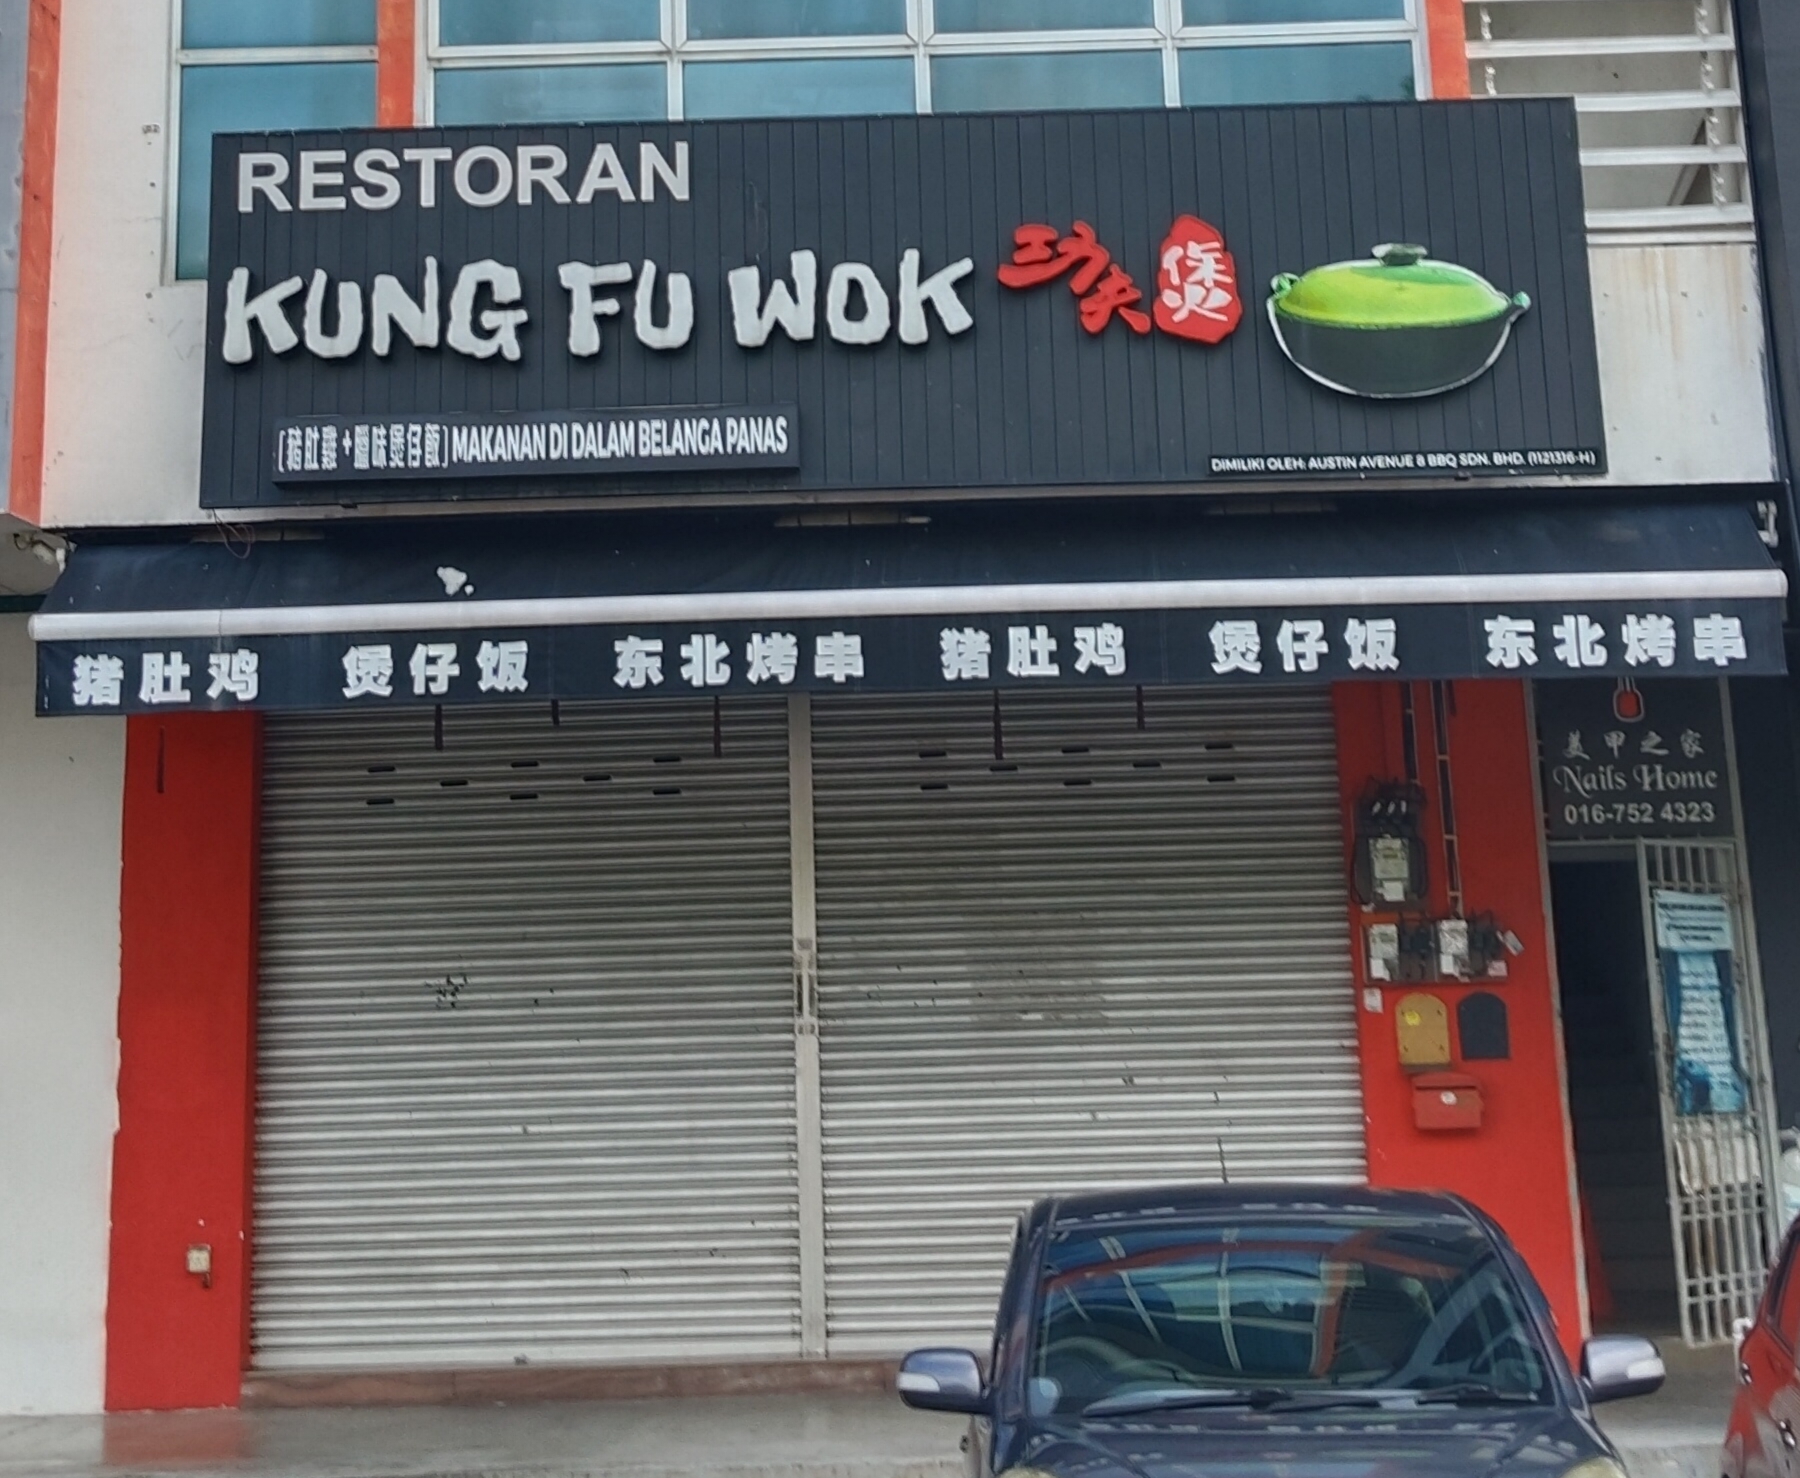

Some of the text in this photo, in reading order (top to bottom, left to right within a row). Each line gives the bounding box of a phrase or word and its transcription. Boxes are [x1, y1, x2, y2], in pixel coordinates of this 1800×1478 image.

[236, 140, 691, 214] RESTORAN
[221, 247, 975, 365] KUNG FU WOK
[452, 415, 788, 463] MAKANAN DI DALAM BELANGA PANAS
[1211, 457, 1266, 472] DIMILIKI
[1307, 455, 1357, 471] AUSTIN
[1358, 454, 1414, 470] AVENUE
[1427, 452, 1458, 469] BBQ
[1458, 452, 1492, 467] SDN.
[72, 613, 1749, 706] 猪肚鸡 煲仔饭 东北烤串 猪肚鸡 煲仔饭 东北烤串
[1561, 728, 1705, 761] 美甲之家
[1553, 764, 1718, 799] Nails Home
[1564, 801, 1717, 825] 016-752 4323
